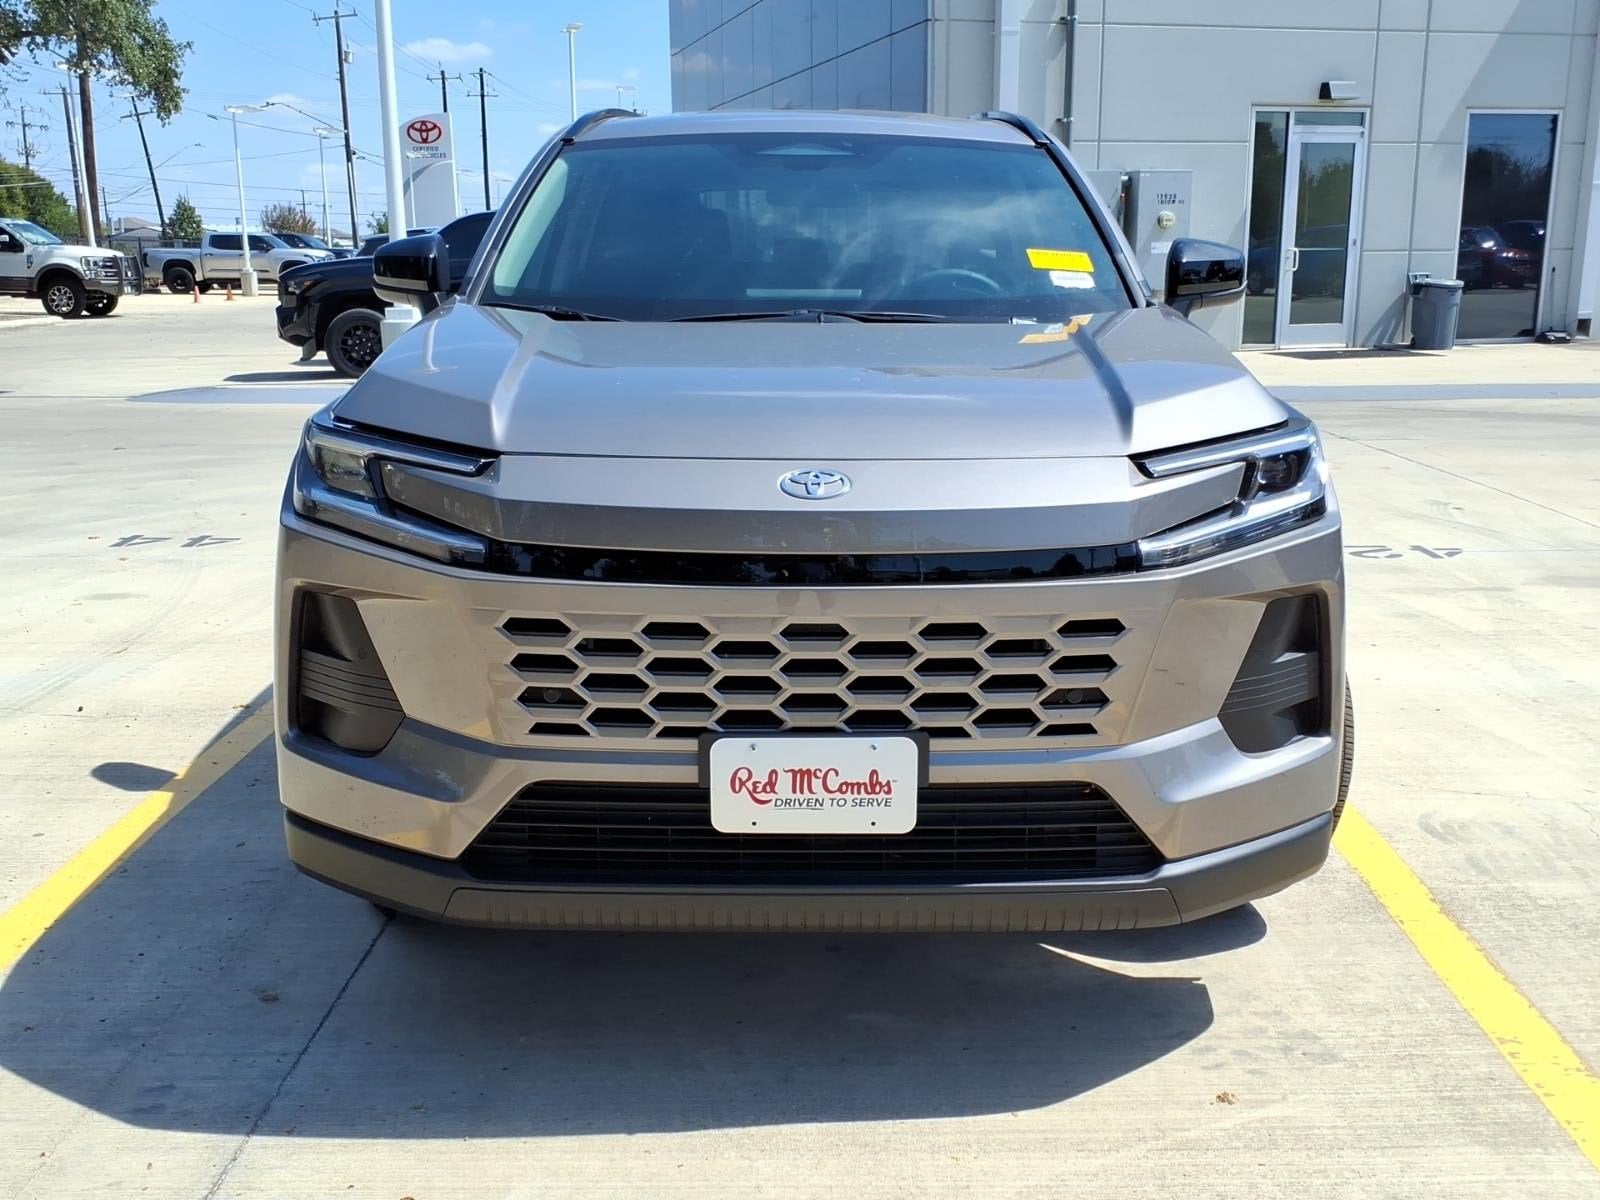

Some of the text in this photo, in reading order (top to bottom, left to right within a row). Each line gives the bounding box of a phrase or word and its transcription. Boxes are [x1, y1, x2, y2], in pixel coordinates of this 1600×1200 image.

[730, 766, 892, 805] Red McCombs
[774, 798, 892, 808] DRIVEN TO SERVE
